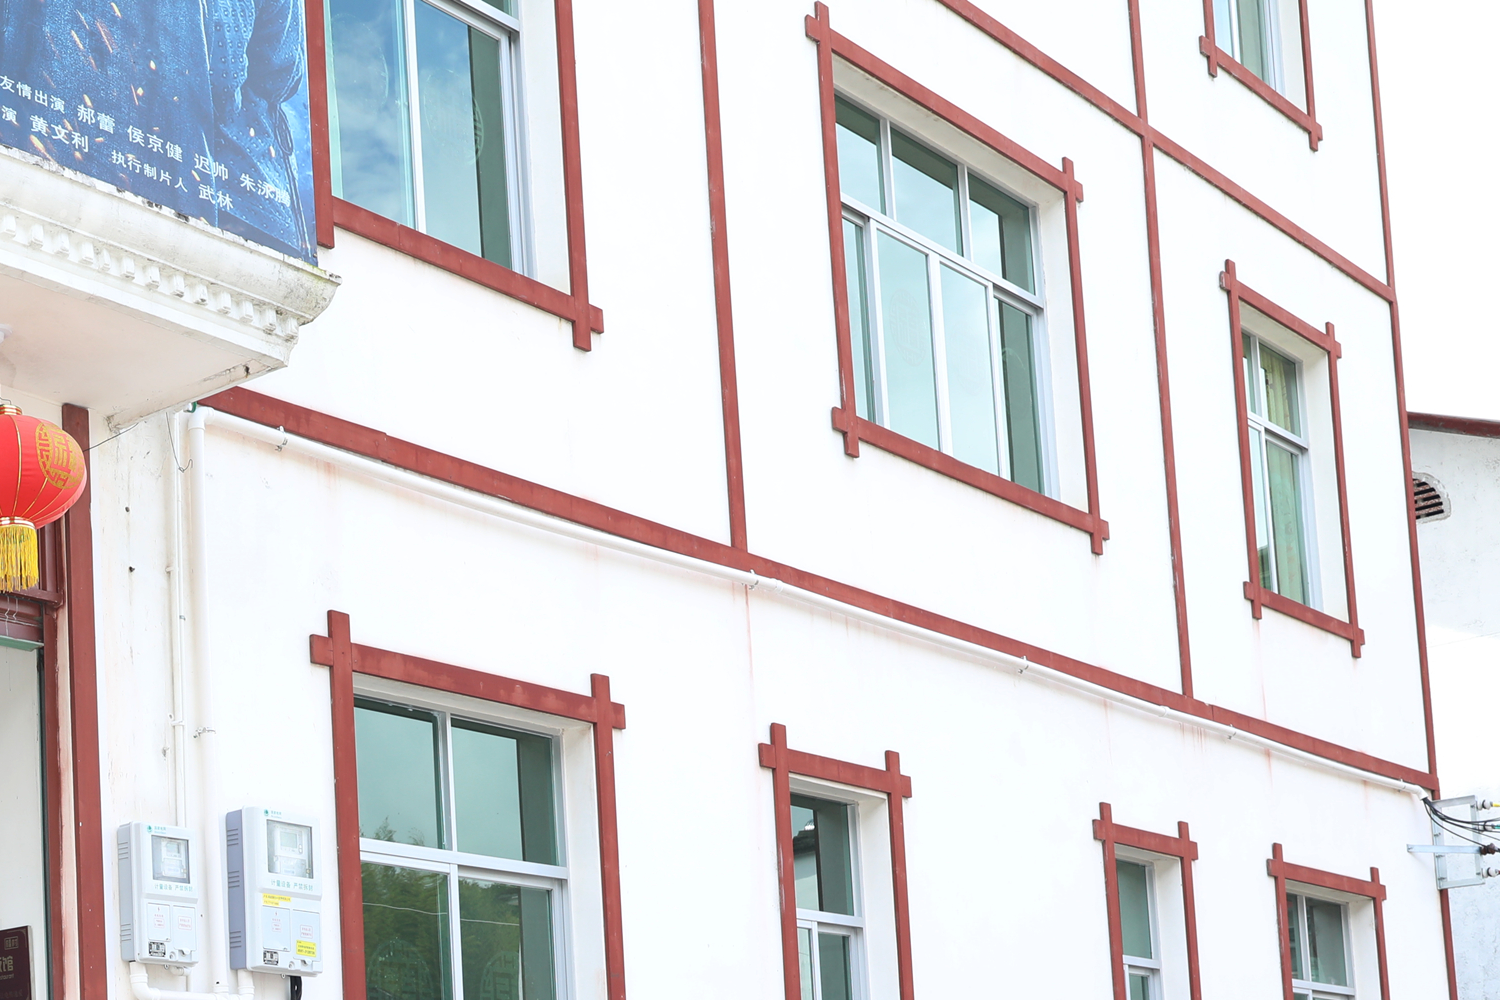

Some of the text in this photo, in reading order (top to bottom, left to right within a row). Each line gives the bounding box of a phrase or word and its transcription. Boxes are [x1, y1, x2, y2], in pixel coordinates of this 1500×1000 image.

[0, 75, 66, 114] 友情出演
[76, 103, 116, 135] 郝蕾
[126, 124, 183, 164] 侯京健
[193, 153, 228, 181] 迟帅
[29, 113, 90, 153] 黄文利
[111, 150, 189, 193] 执行制片人
[198, 183, 234, 211] 武林
